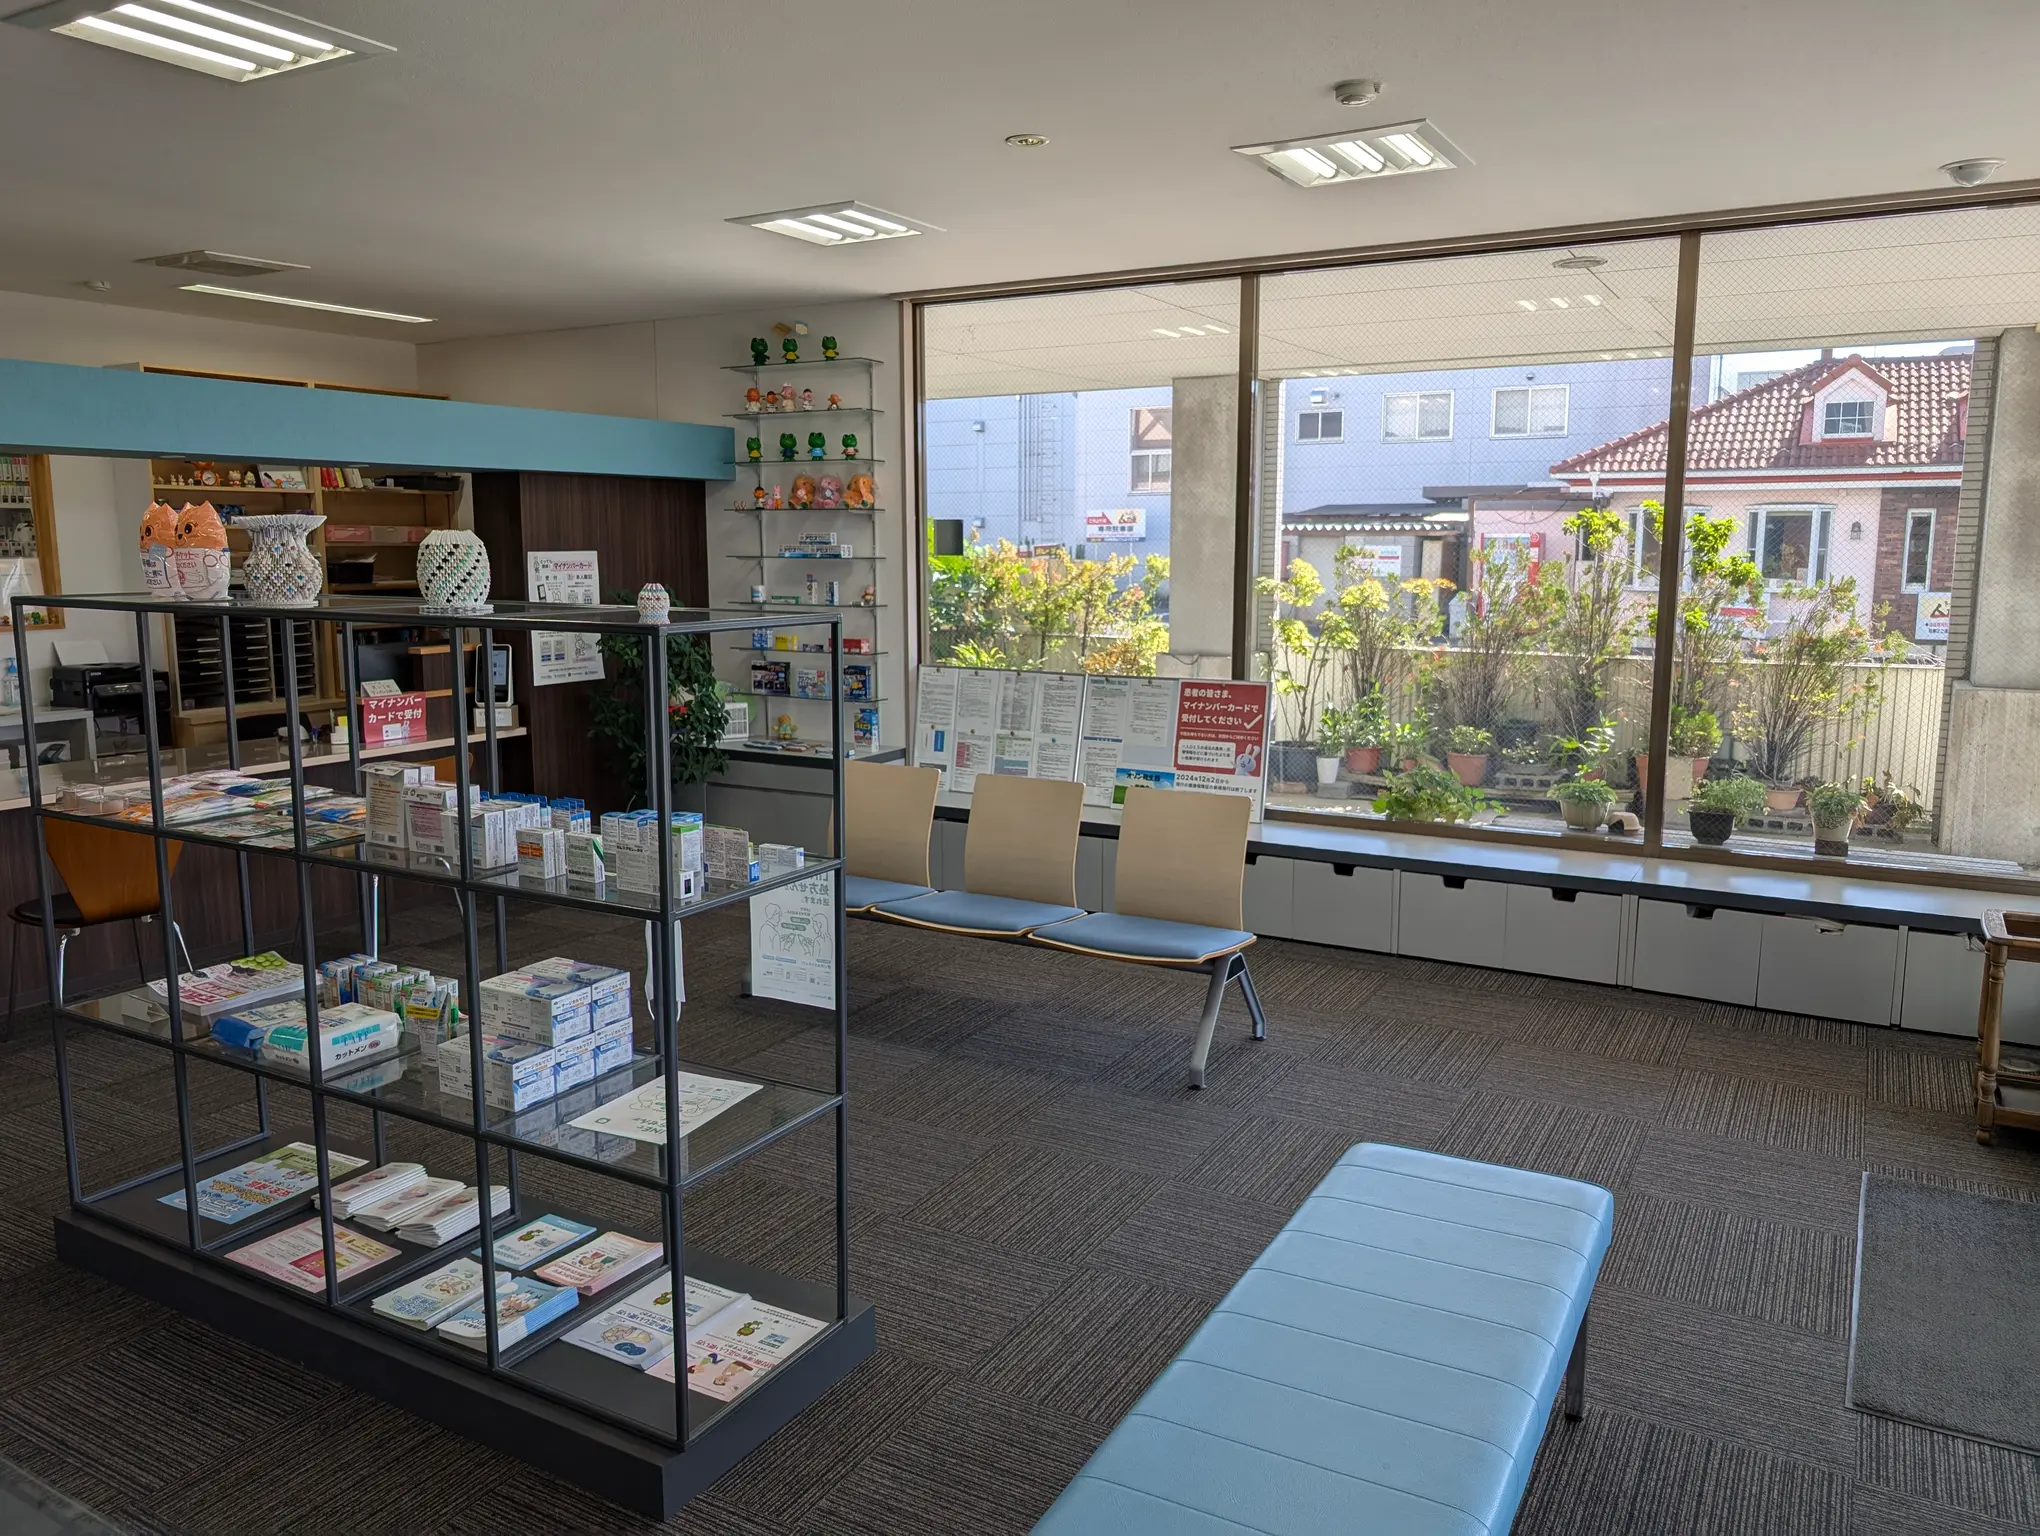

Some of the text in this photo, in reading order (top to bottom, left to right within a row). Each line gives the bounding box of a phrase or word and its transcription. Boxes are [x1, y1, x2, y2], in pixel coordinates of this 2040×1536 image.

[1183, 687, 1232, 699] 患者の皆さま、
[368, 695, 422, 710] マイナンバー
[1182, 701, 1259, 713] マイナンバーカードで
[368, 708, 423, 724] カードで受付
[1181, 713, 1242, 725] 受付してください
[1176, 773, 1229, 784] 2024年12月2日から
[335, 1044, 368, 1061] カットメン
